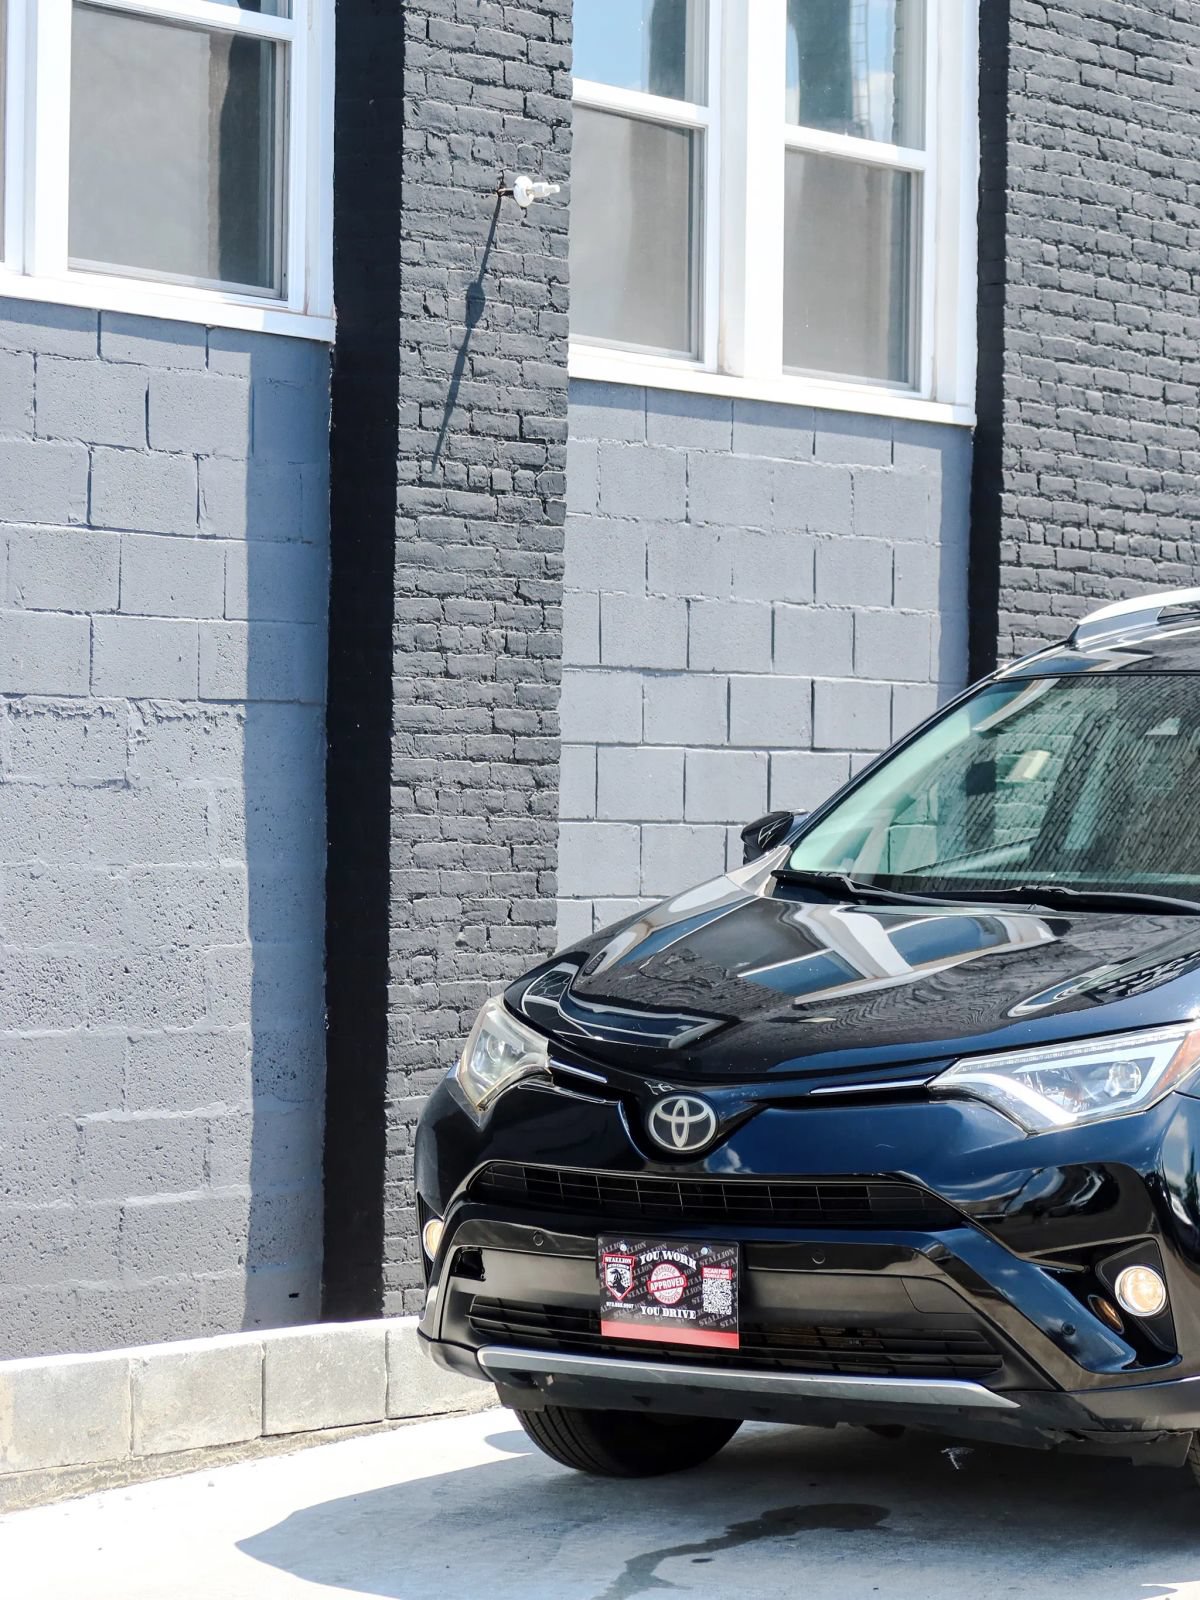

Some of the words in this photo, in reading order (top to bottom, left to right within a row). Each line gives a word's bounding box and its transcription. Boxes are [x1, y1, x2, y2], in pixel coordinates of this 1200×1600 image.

[640, 1250, 660, 1266] YOU
[661, 1250, 697, 1270] WORK
[650, 1278, 684, 1291] APPROVED
[640, 1305, 660, 1316] YOU
[661, 1307, 697, 1320] DRIVE
